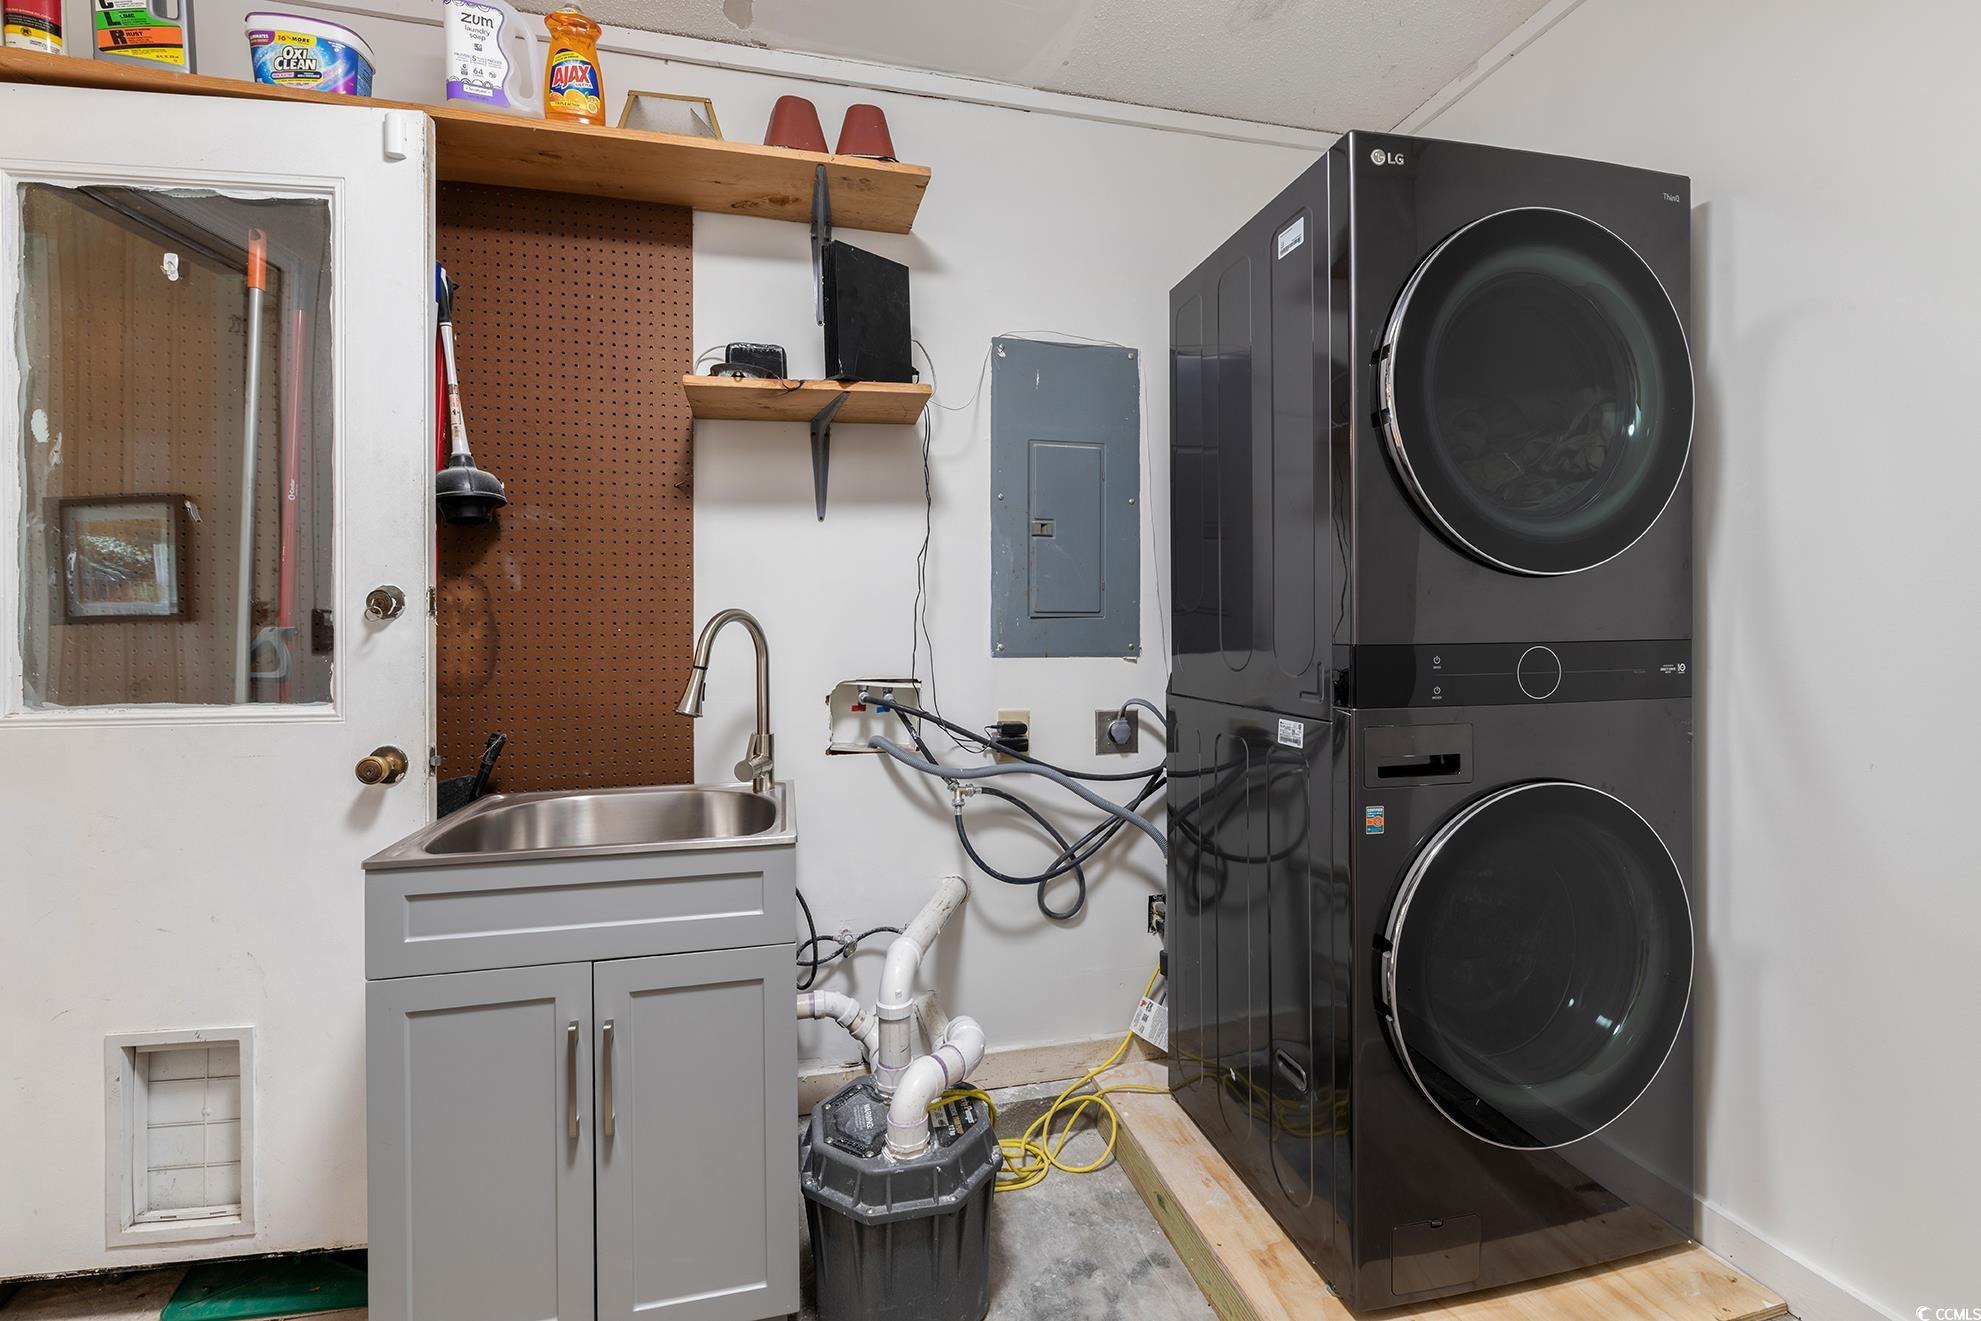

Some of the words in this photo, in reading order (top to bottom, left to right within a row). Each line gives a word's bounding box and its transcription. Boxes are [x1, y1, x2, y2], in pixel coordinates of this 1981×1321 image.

[104, 11, 122, 26] L
[461, 12, 494, 29] zum
[109, 29, 128, 45] R
[464, 24, 491, 37] laundry
[469, 33, 487, 42] soap
[283, 46, 307, 59] OXI
[275, 56, 317, 70] CLEAN
[553, 65, 591, 87] AJAX
[1387, 152, 1405, 165] LG
